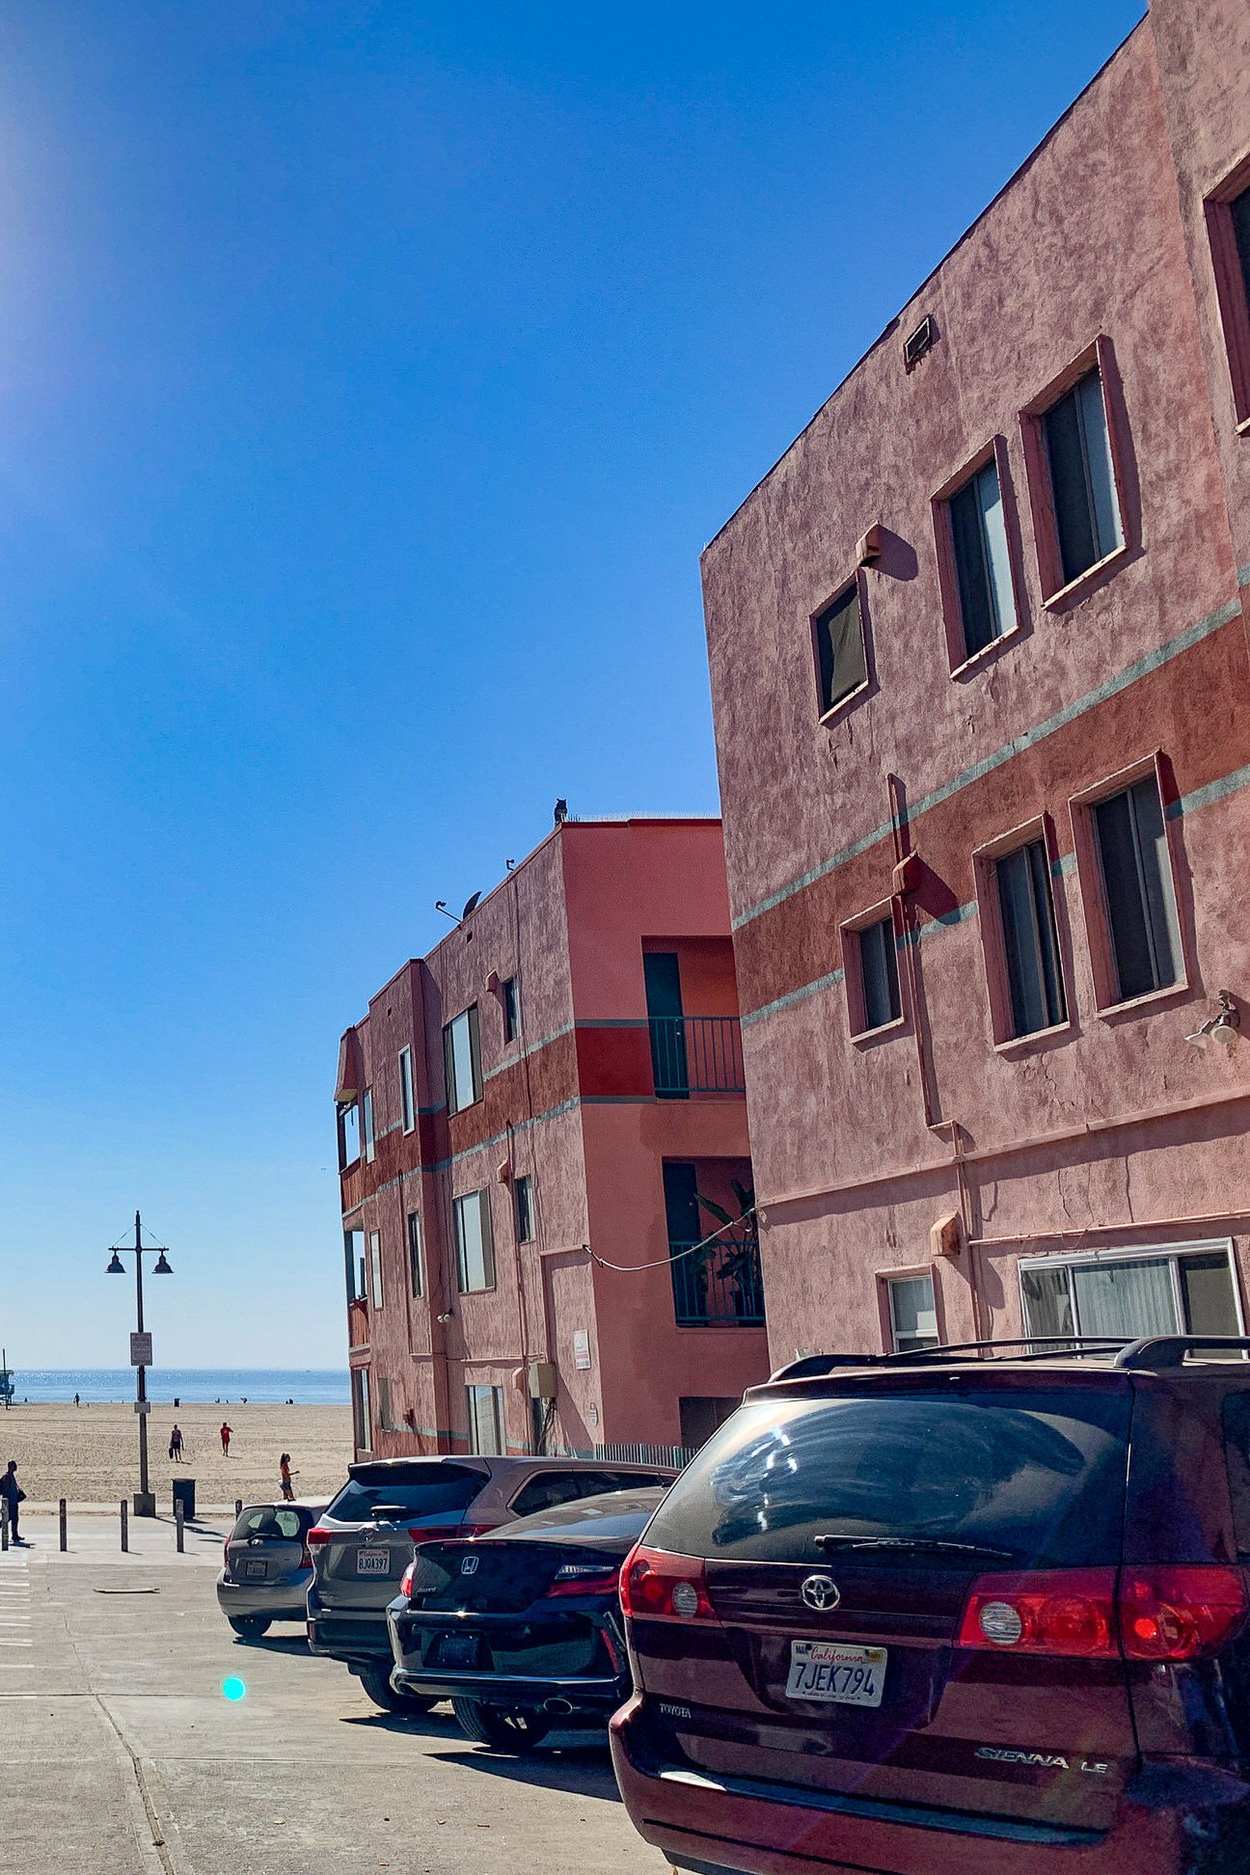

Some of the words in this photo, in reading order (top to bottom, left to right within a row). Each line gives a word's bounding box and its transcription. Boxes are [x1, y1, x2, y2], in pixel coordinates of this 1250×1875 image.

[810, 1646, 868, 1665] California
[795, 1662, 875, 1697] 7JEK794
[659, 1703, 692, 1718] TOYOTA
[974, 1747, 1069, 1769] SIENNA
[1081, 1761, 1108, 1774] LE
